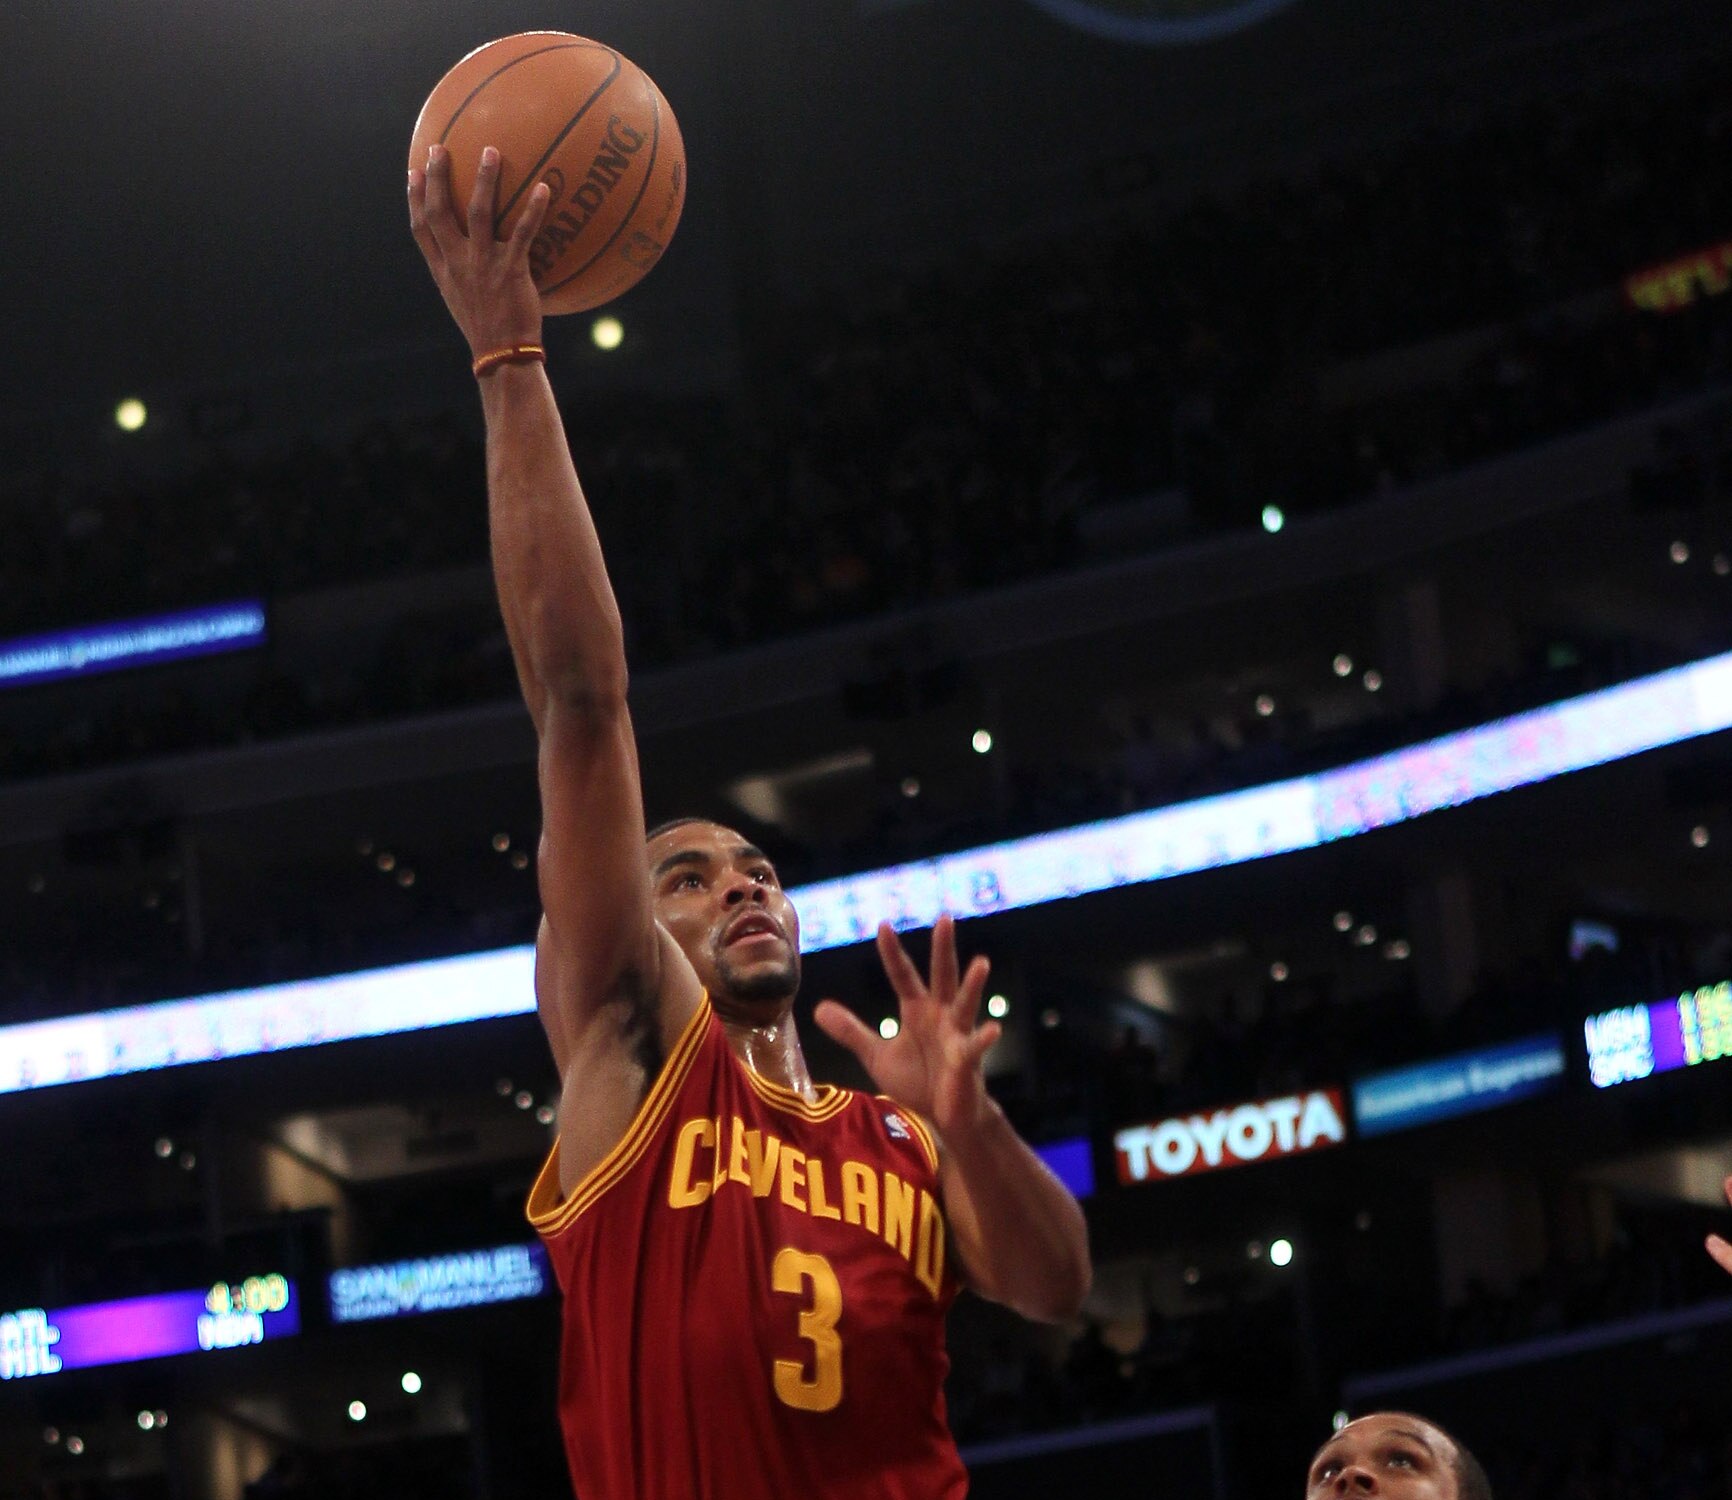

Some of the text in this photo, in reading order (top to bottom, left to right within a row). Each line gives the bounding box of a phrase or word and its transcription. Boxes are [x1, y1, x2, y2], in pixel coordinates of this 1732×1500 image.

[668, 1115, 945, 1301] CLEVELAND
[1114, 1091, 1346, 1181] TOYOTA
[771, 1247, 843, 1413] 3
